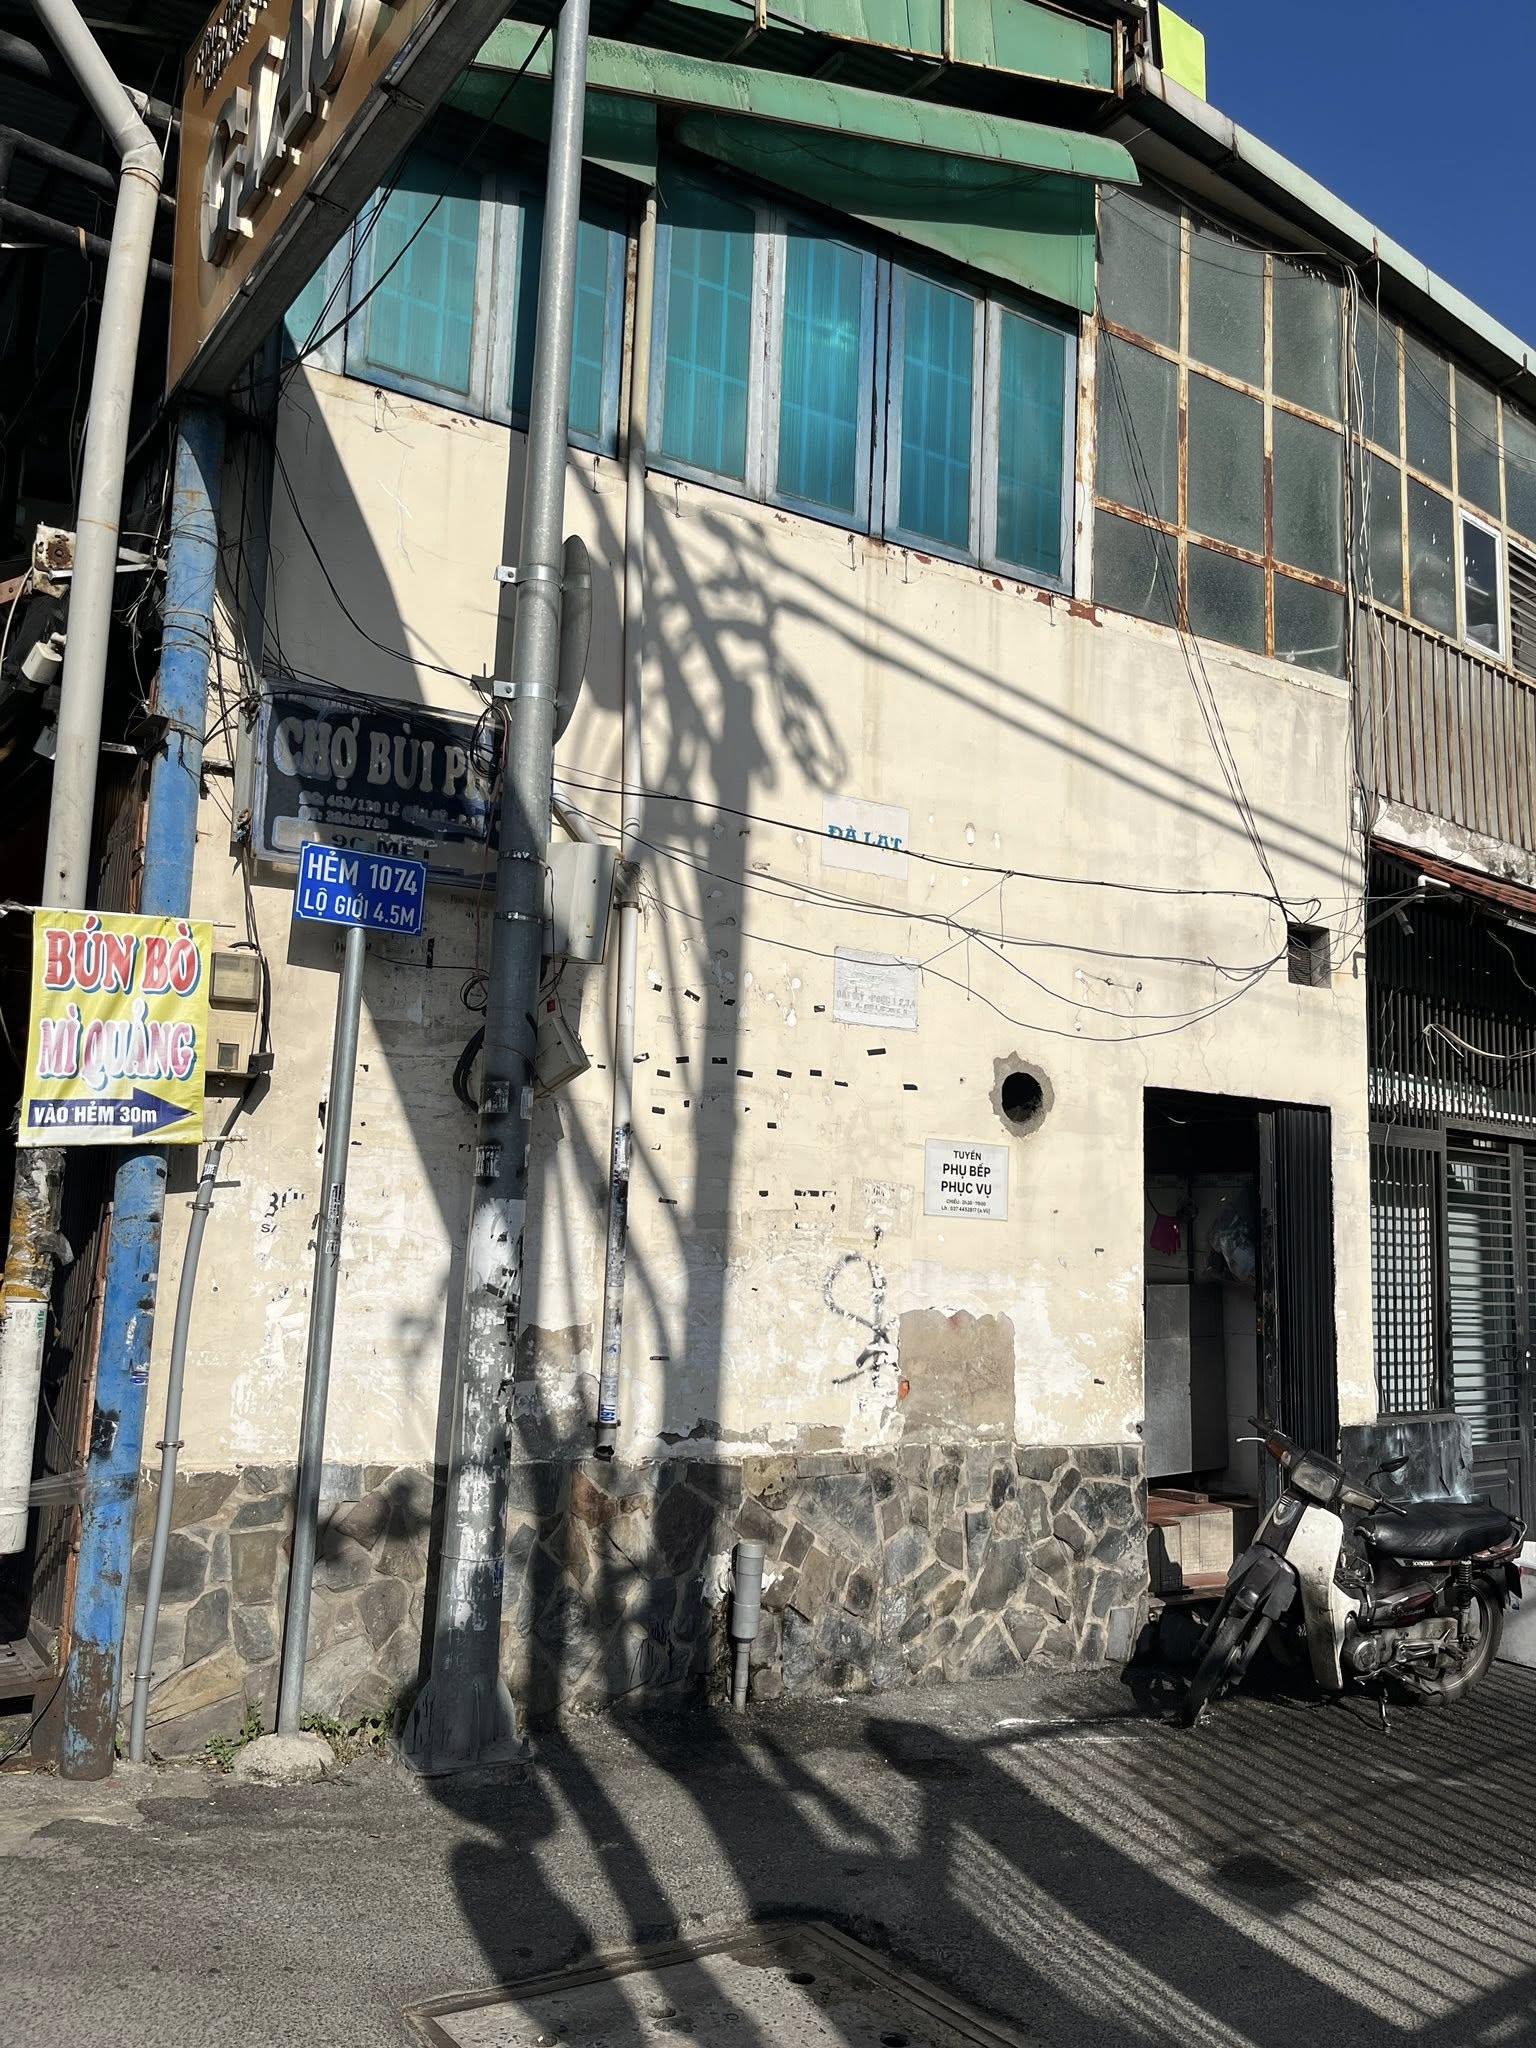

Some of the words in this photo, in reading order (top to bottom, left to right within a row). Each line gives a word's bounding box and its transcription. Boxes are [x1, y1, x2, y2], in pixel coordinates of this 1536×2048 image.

[274, 717, 360, 791] CHỢ
[367, 723, 435, 792] BÙI
[828, 824, 857, 841] ĐÀ
[307, 851, 359, 886] HẺM
[369, 863, 417, 896] 1074
[303, 887, 328, 916] LỘ
[334, 892, 369, 920] GIỚI
[373, 902, 415, 927] 4.5M
[43, 915, 138, 992] BÚN
[142, 922, 199, 993] BÒ
[38, 1003, 81, 1078] MÌ
[82, 999, 195, 1088] QUẢNG
[34, 1103, 69, 1123] VÀO
[74, 1101, 114, 1123] HẺM
[120, 1106, 157, 1123] 30m
[941, 1181, 973, 1196] PHỤC
[976, 1183, 992, 1198] VỤ
[943, 1163, 966, 1179] PHỤ
[969, 1163, 991, 1178] BẾP
